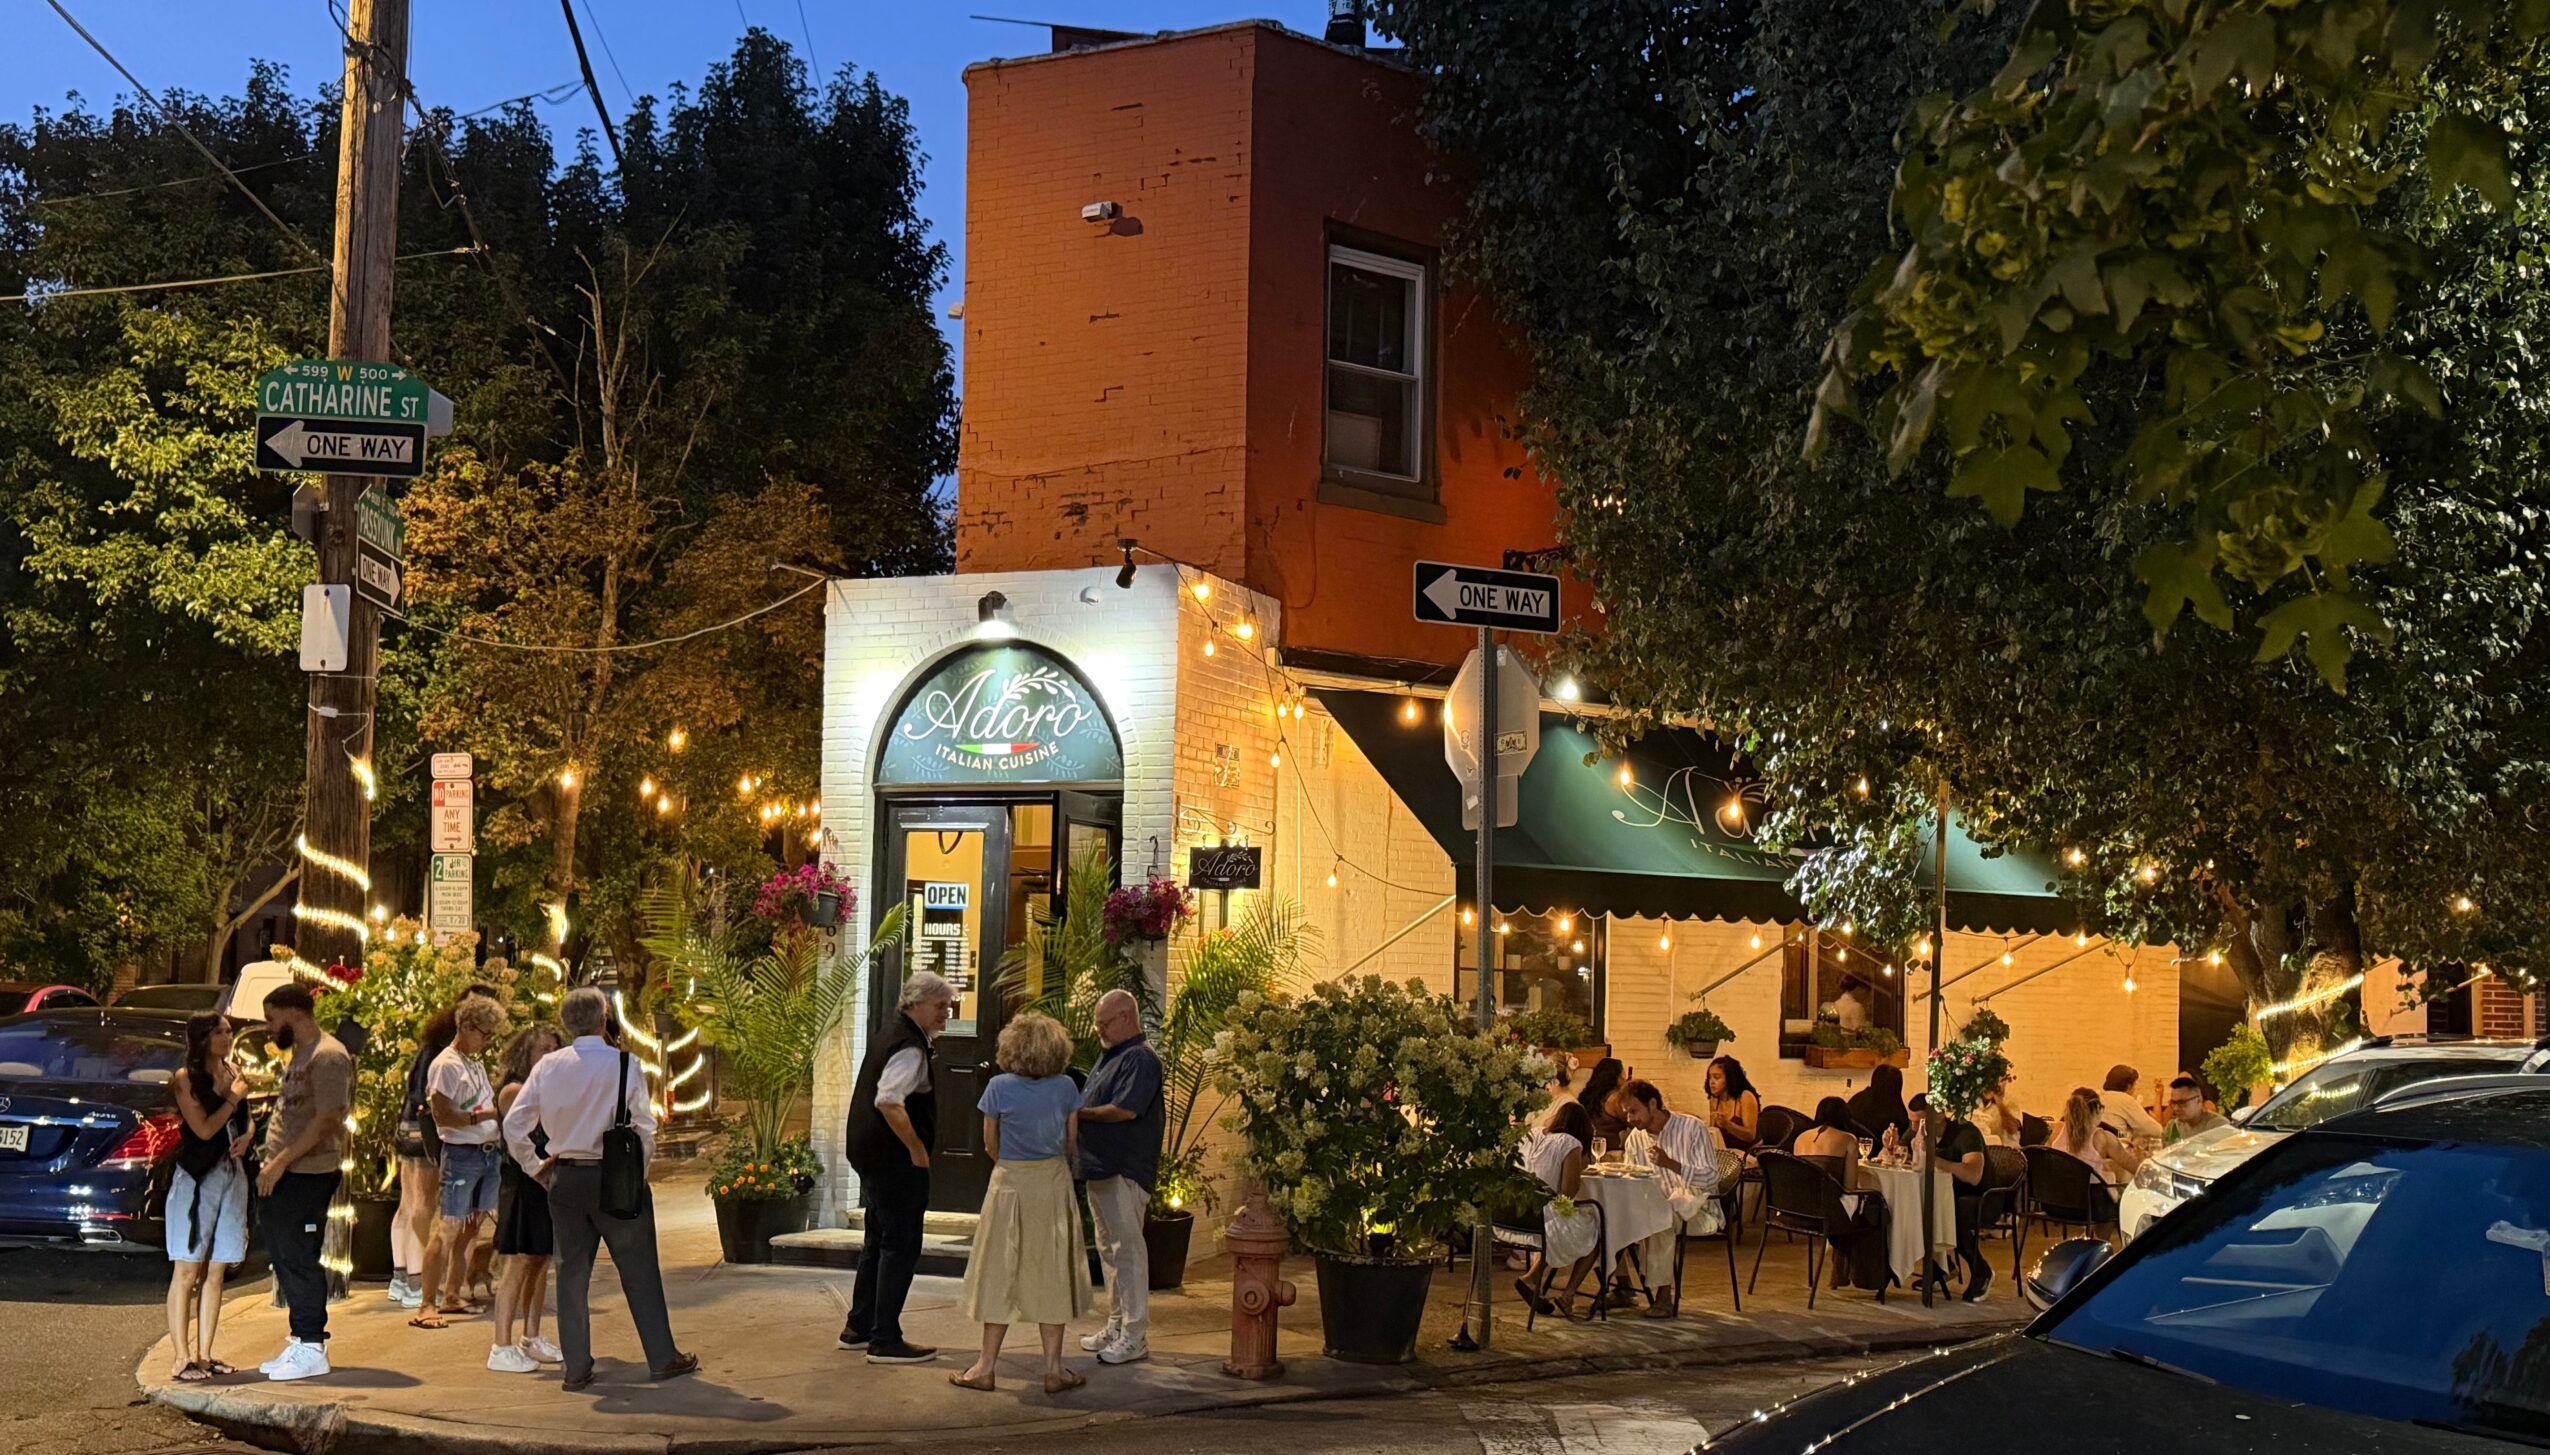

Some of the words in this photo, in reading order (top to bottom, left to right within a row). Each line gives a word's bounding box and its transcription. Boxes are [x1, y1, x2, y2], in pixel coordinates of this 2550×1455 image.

[302, 366, 328, 377] 599
[337, 366, 353, 381] W
[360, 368, 388, 380] 500
[265, 381, 392, 417] CATHARINE
[400, 397, 419, 418] ST
[307, 434, 351, 456] ONE
[361, 437, 406, 459] WAY
[360, 503, 396, 553] PASSYUNK
[362, 557, 377, 584] ONE
[377, 565, 391, 592] WAY
[1460, 585, 1498, 609] ONE
[1506, 590, 1544, 614] WAY
[904, 668, 1093, 740] Adoro
[936, 743, 992, 770] ITALIAN
[999, 741, 1059, 770] CUISINE
[435, 788, 444, 801] NO
[446, 789, 469, 799] PARKING
[444, 809, 460, 820] ANY
[443, 822, 461, 833] TIME
[435, 860, 443, 879] 2
[451, 858, 461, 868] HR
[445, 868, 469, 879] PARKING
[1191, 851, 1258, 877] Adoro
[927, 886, 967, 905] OPEN
[924, 922, 961, 936] HOURS
